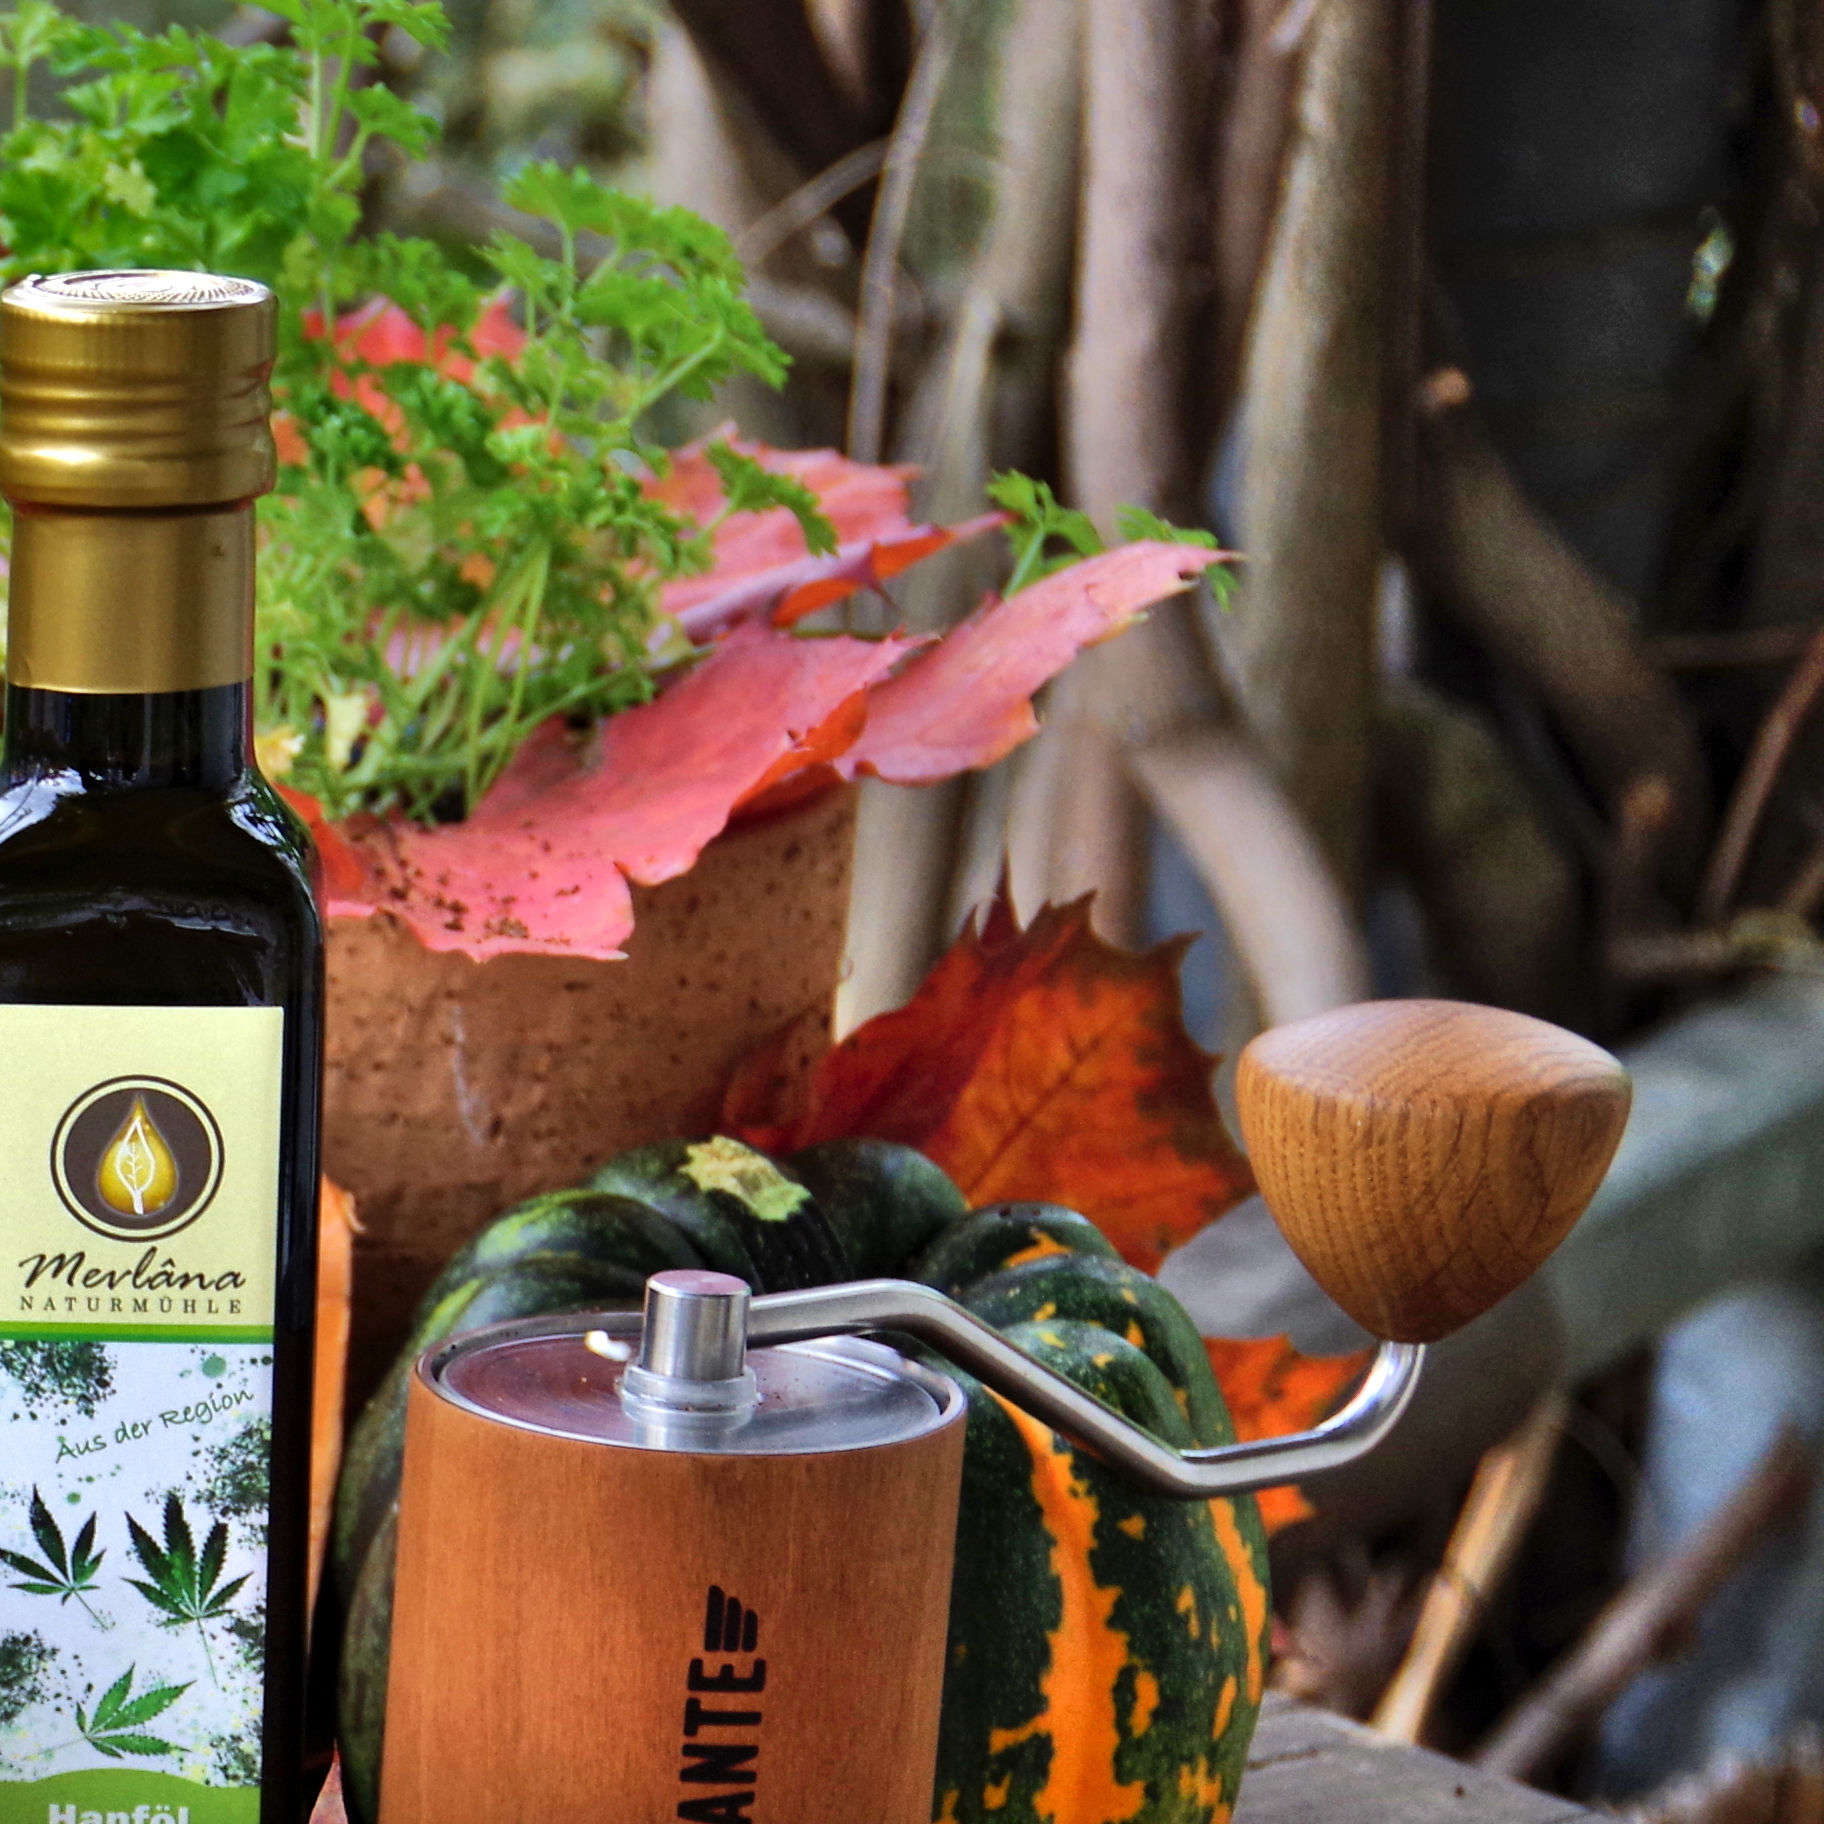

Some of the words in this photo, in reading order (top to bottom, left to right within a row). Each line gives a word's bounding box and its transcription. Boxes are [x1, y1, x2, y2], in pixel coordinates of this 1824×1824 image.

[18, 1246, 246, 1291] Mevlâna
[20, 1295, 243, 1315] NATURMÜHLE
[55, 1434, 107, 1464] Aus
[115, 1420, 152, 1444] der
[159, 1388, 254, 1428] Region
